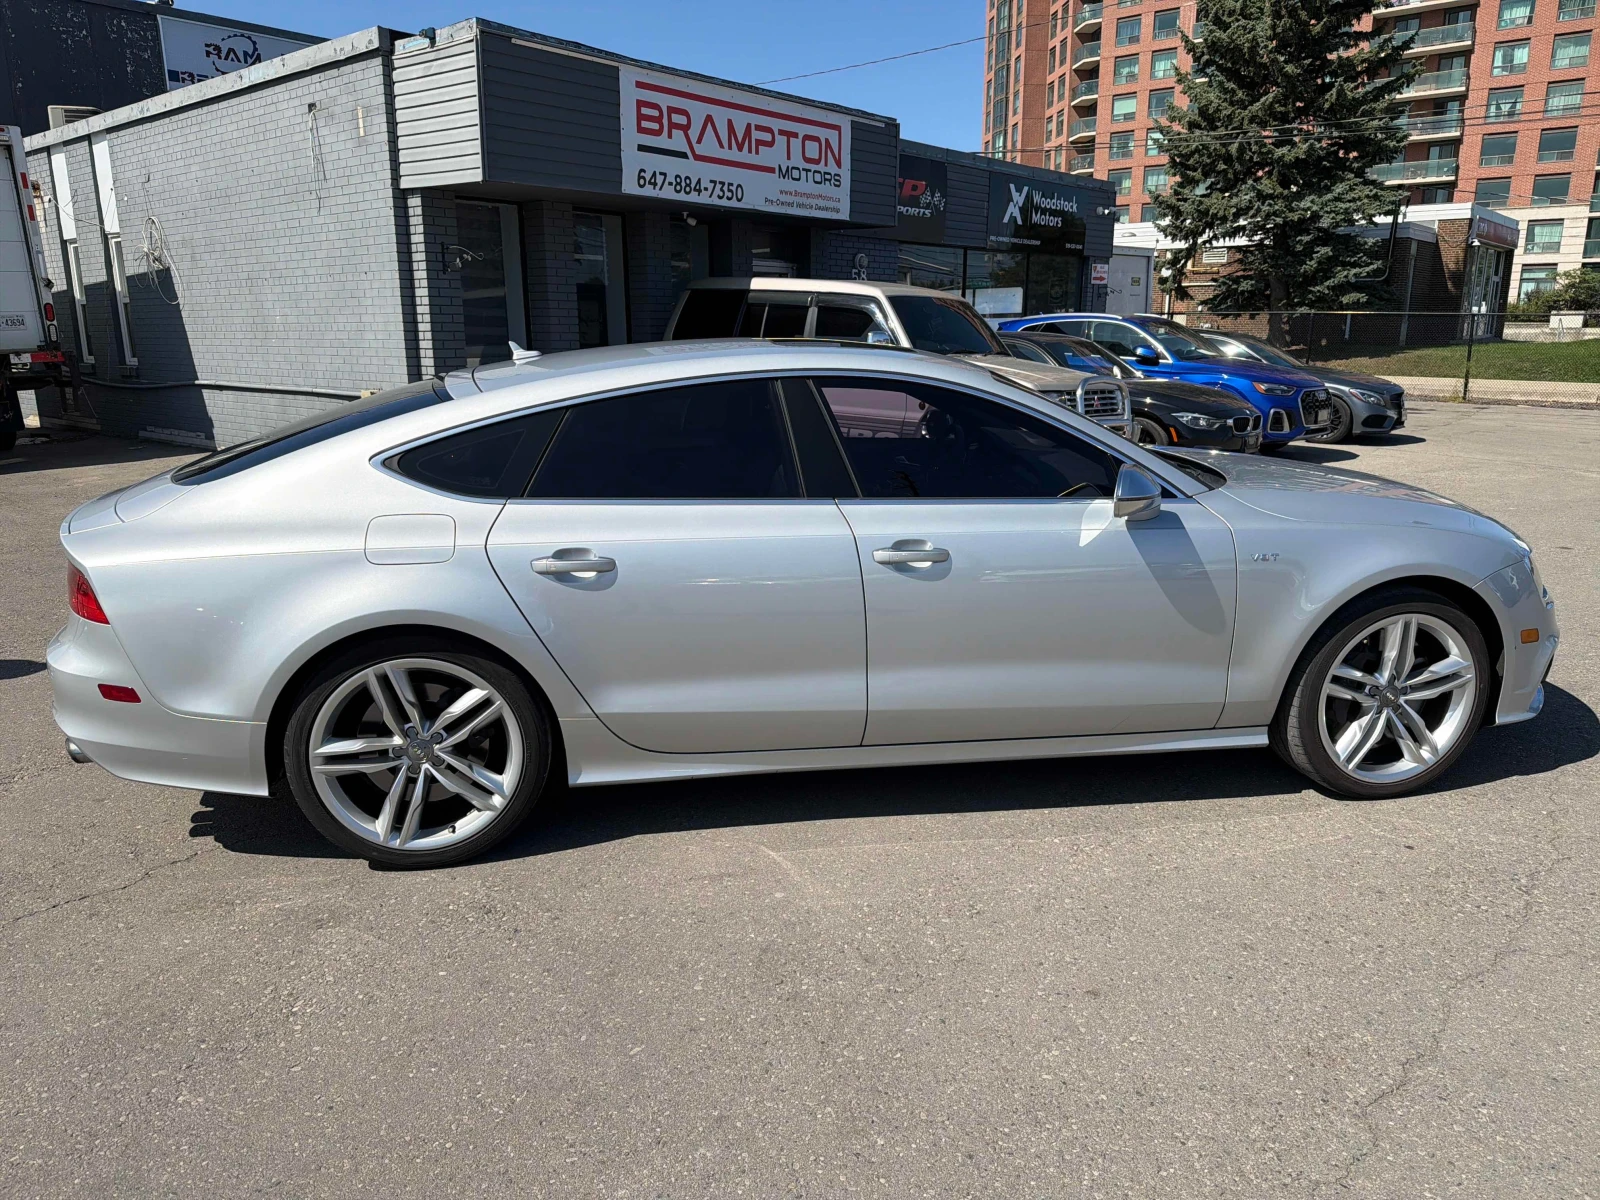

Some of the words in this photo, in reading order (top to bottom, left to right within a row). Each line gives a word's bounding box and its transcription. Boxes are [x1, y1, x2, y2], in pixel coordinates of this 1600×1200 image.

[205, 43, 261, 64] RAM
[636, 99, 841, 169] BRAMPTON
[637, 168, 743, 202] 647-884-7350
[778, 164, 841, 188] MOTORS
[765, 197, 794, 208] Pre-Owned
[796, 201, 813, 210] Vehicle
[814, 203, 840, 214] Dealership
[779, 189, 840, 203] www.BramptonMotors.ca
[1032, 190, 1078, 213] Woodstock
[1032, 208, 1062, 227] Motors
[852, 268, 867, 280] 58
